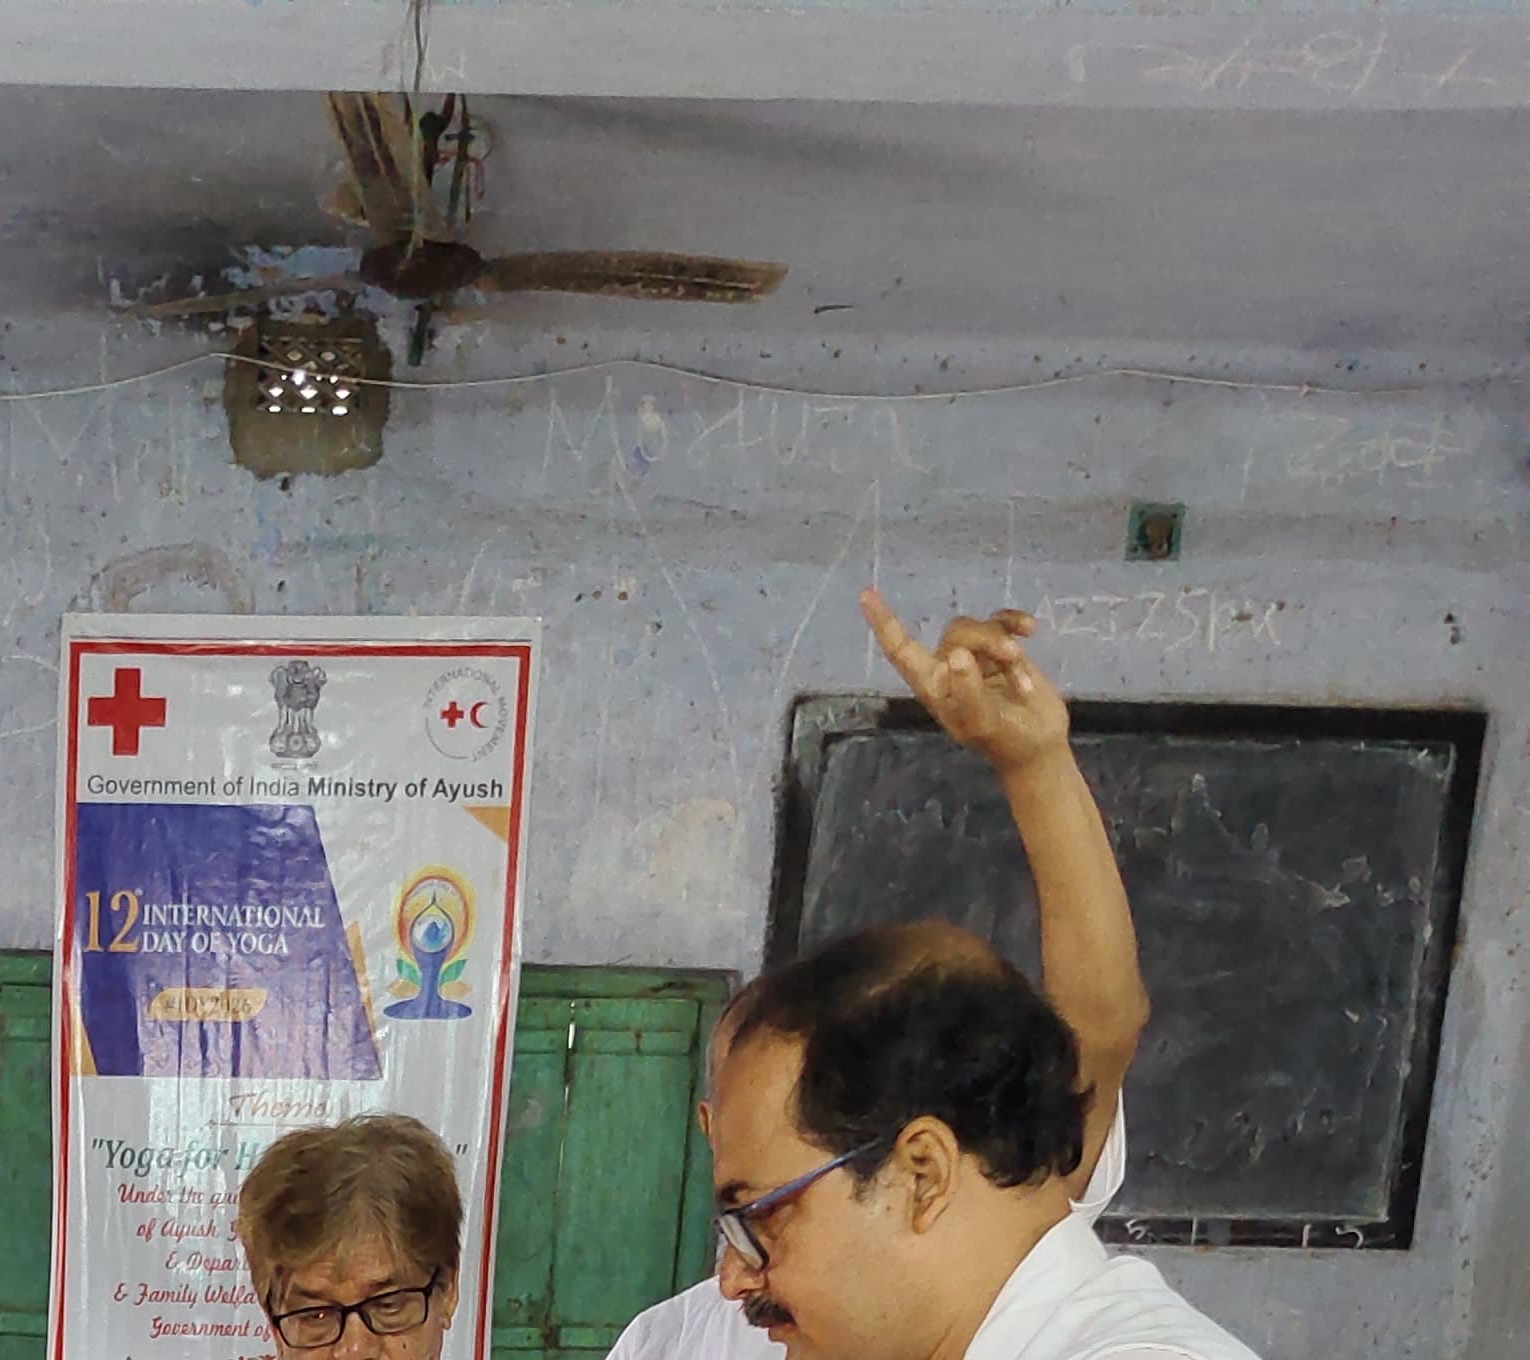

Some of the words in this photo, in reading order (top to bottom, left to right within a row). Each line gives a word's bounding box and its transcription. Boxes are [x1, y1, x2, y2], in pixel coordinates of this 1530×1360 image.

[87, 775, 216, 797] Government
[223, 775, 245, 796] of
[250, 776, 299, 797] India
[307, 777, 397, 802] Ministry
[405, 778, 428, 798] of
[432, 778, 504, 803] Ayush
[142, 904, 325, 928] INTERNATIONAL
[142, 931, 187, 953] DAY
[192, 932, 220, 954] OF
[226, 934, 288, 955] YOGA
[177, 1140, 229, 1178] for
[136, 1217, 156, 1242] of
[113, 1283, 129, 1302] &
[133, 1282, 198, 1309] Family
[204, 1284, 256, 1309] Welfa
[149, 1316, 250, 1338] Government
